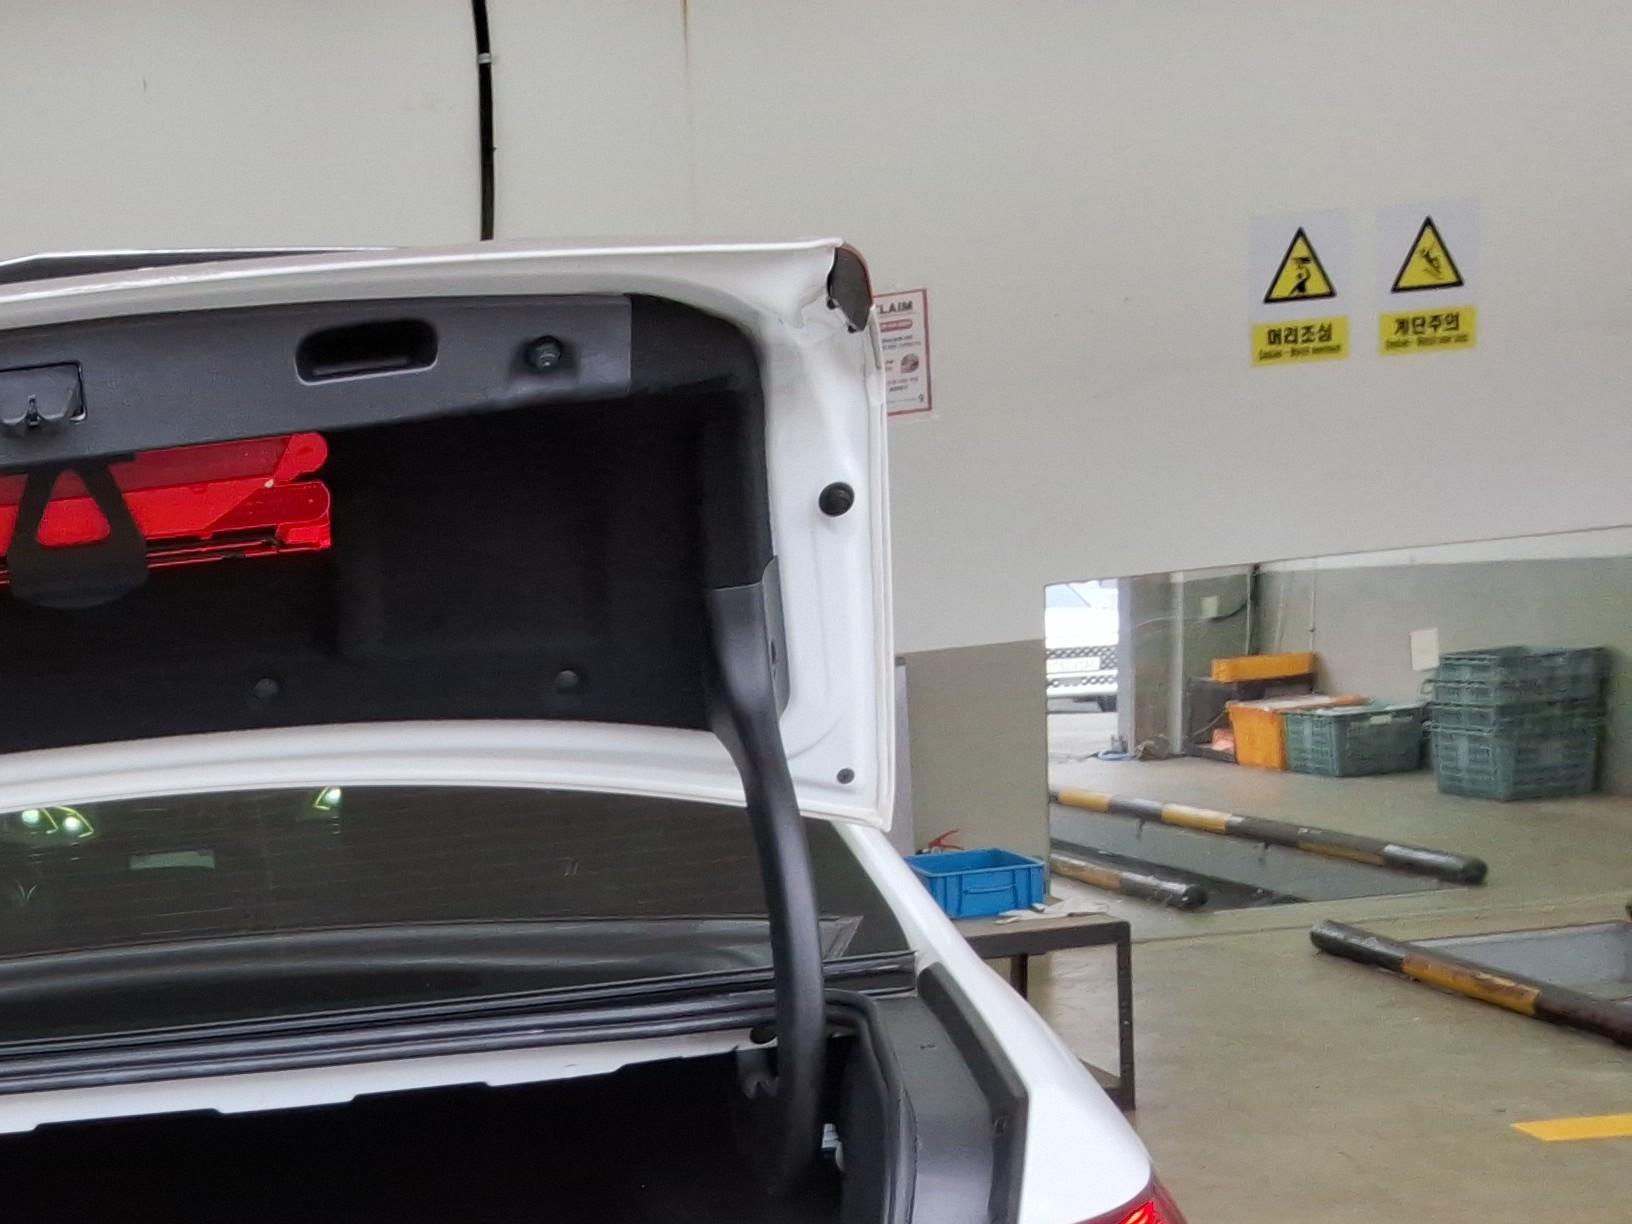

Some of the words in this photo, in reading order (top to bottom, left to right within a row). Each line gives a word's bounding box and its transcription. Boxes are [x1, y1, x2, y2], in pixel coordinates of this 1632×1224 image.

[876, 300, 913, 315] LAIM
[1267, 322, 1332, 346] 머리조심
[1394, 312, 1459, 336] 계단주의
